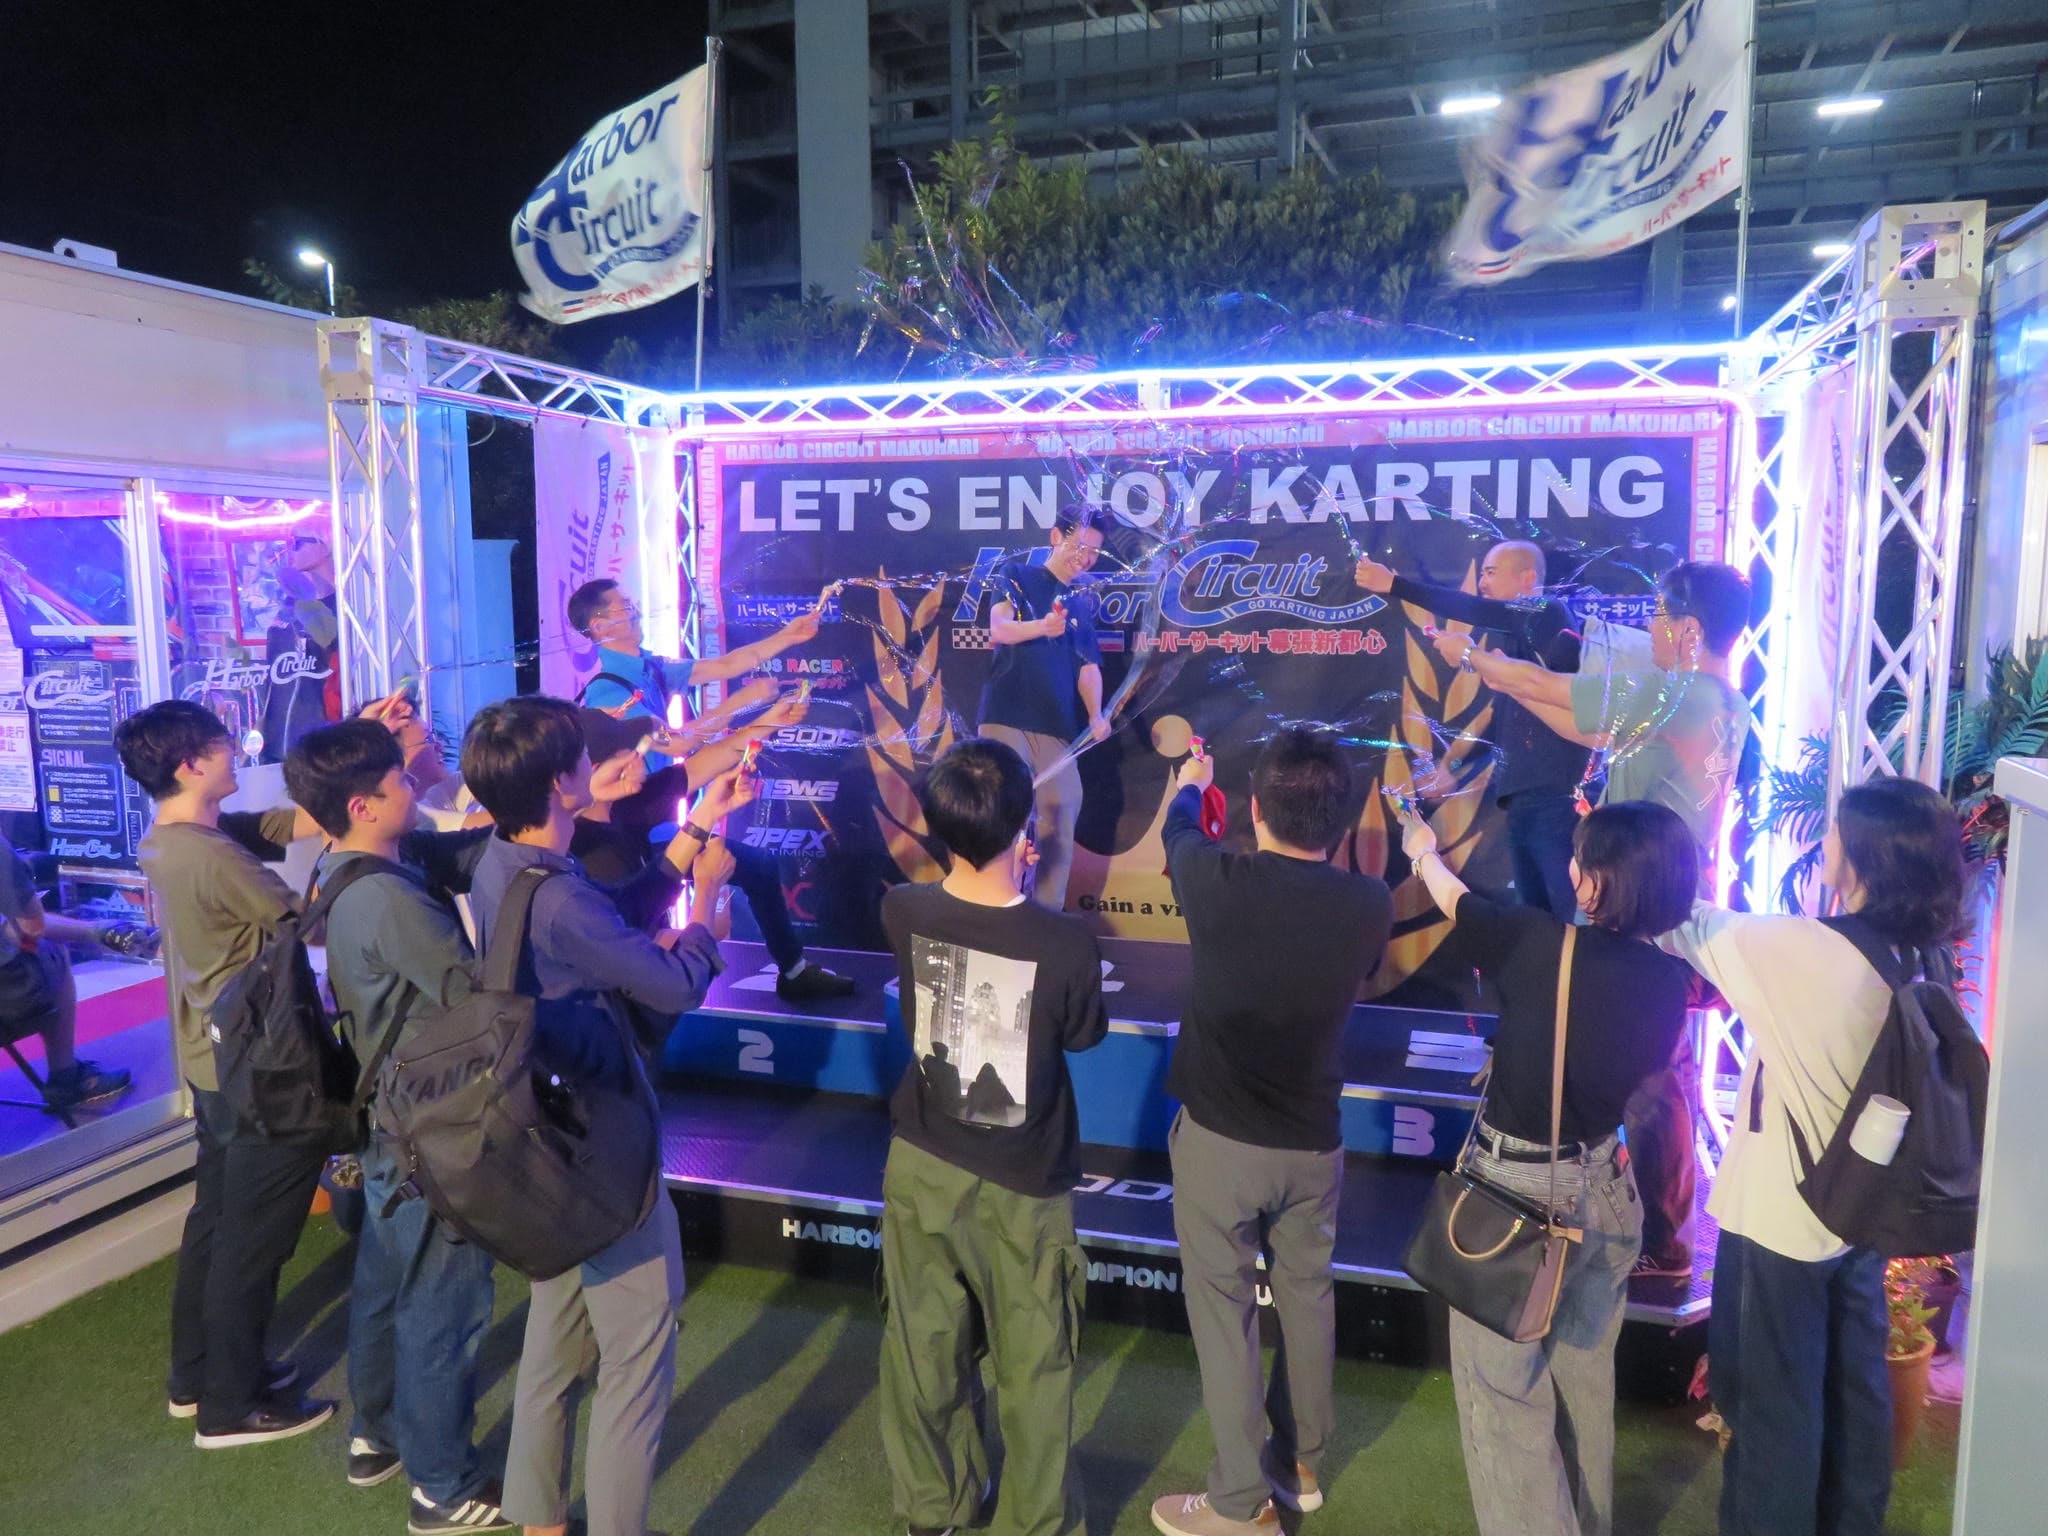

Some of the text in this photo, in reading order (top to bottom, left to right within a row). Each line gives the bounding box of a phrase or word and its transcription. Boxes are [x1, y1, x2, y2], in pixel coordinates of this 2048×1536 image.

[1388, 411, 1720, 438] HARBOR CIRCUIT MAKUHARI
[725, 437, 979, 460] HARBOR CIRCUIT MAKUHARI
[1249, 455, 1665, 525] KARTING
[1695, 436, 1719, 533] HARBOR
[1158, 539, 1388, 628] Circuit
[1248, 600, 1375, 621] GO KARTING JAPAN
[205, 651, 334, 691] Harbor Circuit
[787, 658, 844, 673] RACER
[769, 847, 827, 858] TIMING
[1078, 894, 1135, 914] Gain
[1140, 901, 1154, 915] a
[737, 1028, 775, 1075] 2
[1392, 1105, 1436, 1157] 3
